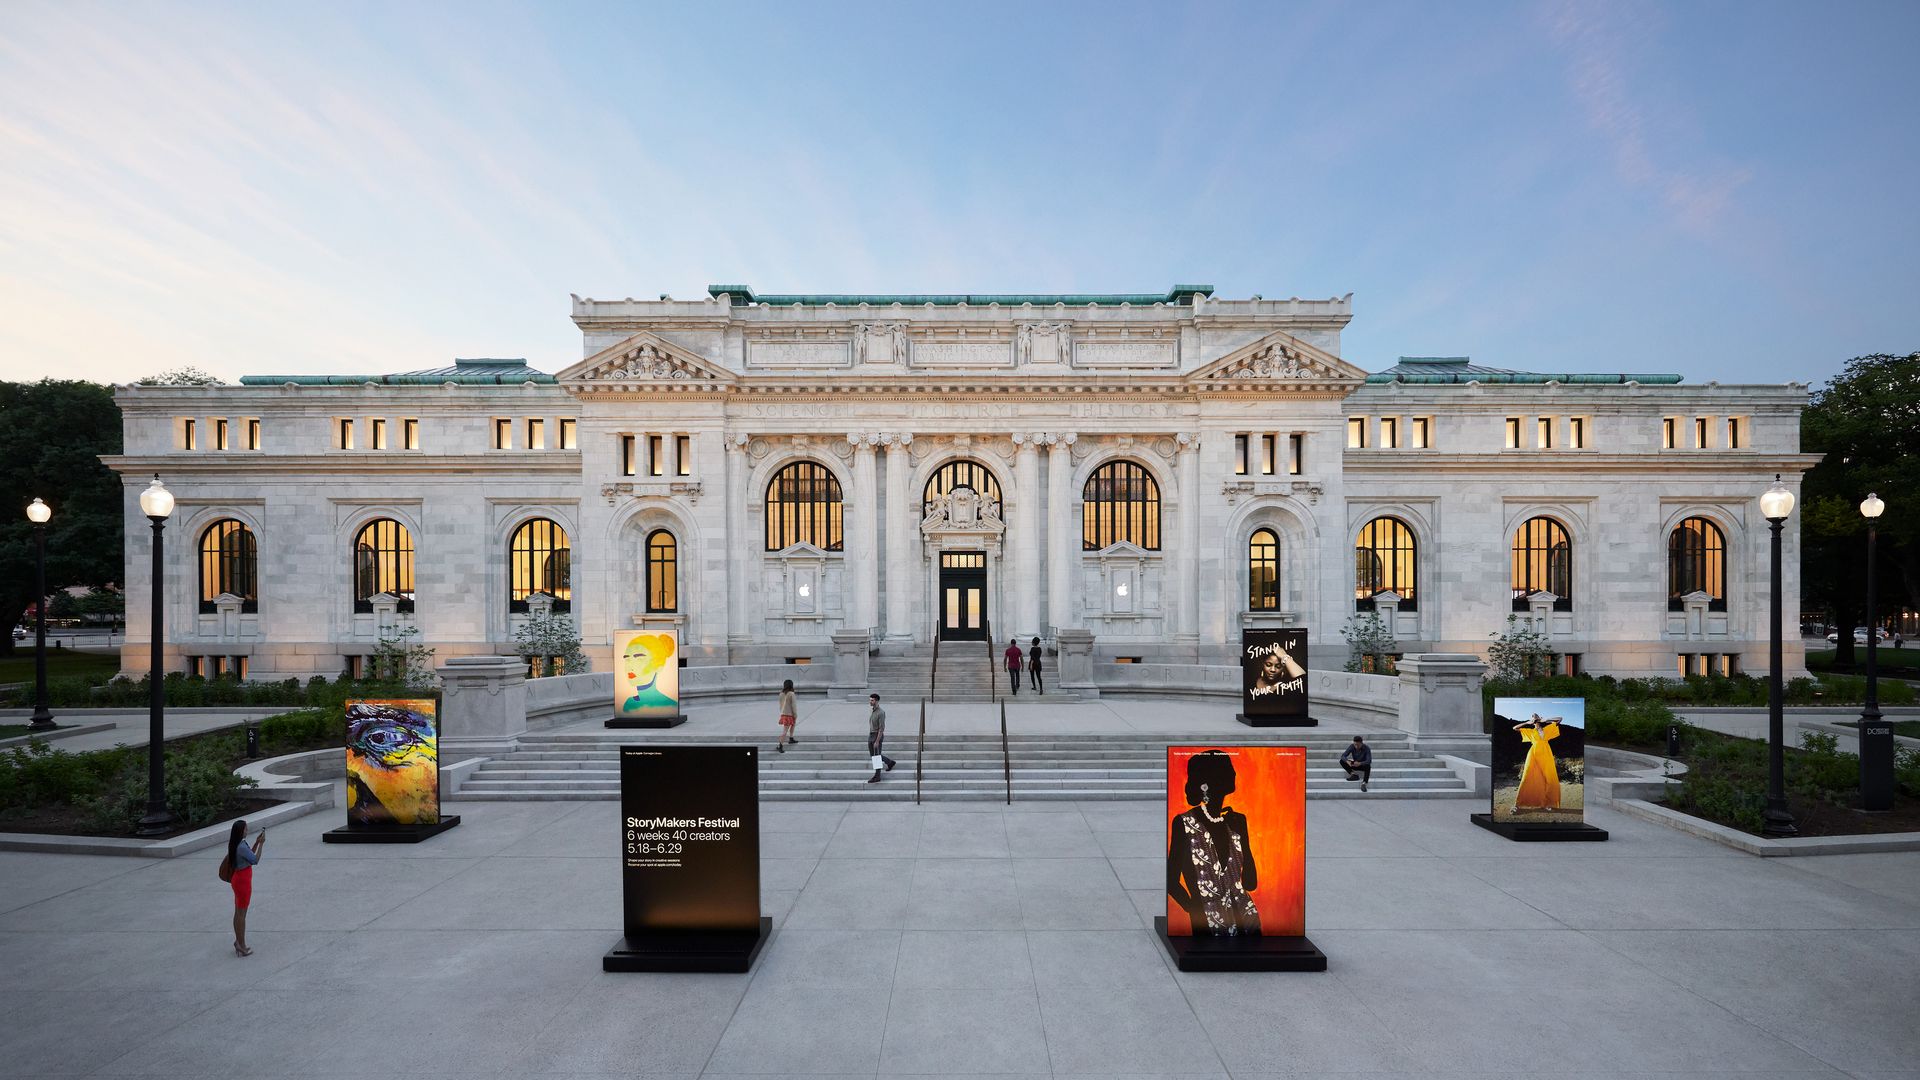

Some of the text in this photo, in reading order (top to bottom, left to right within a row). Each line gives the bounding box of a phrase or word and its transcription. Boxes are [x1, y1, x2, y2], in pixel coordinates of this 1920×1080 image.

[753, 404, 845, 417] SCIENCE
[920, 404, 1006, 417] POETRY
[1083, 404, 1172, 417] HISTORY
[1247, 639, 1296, 659] STAND IN
[1249, 678, 1304, 700] YOUR TRUTH
[627, 817, 740, 830] StoryMakers Festival
[627, 830, 731, 841] 6 weeks 40 creators
